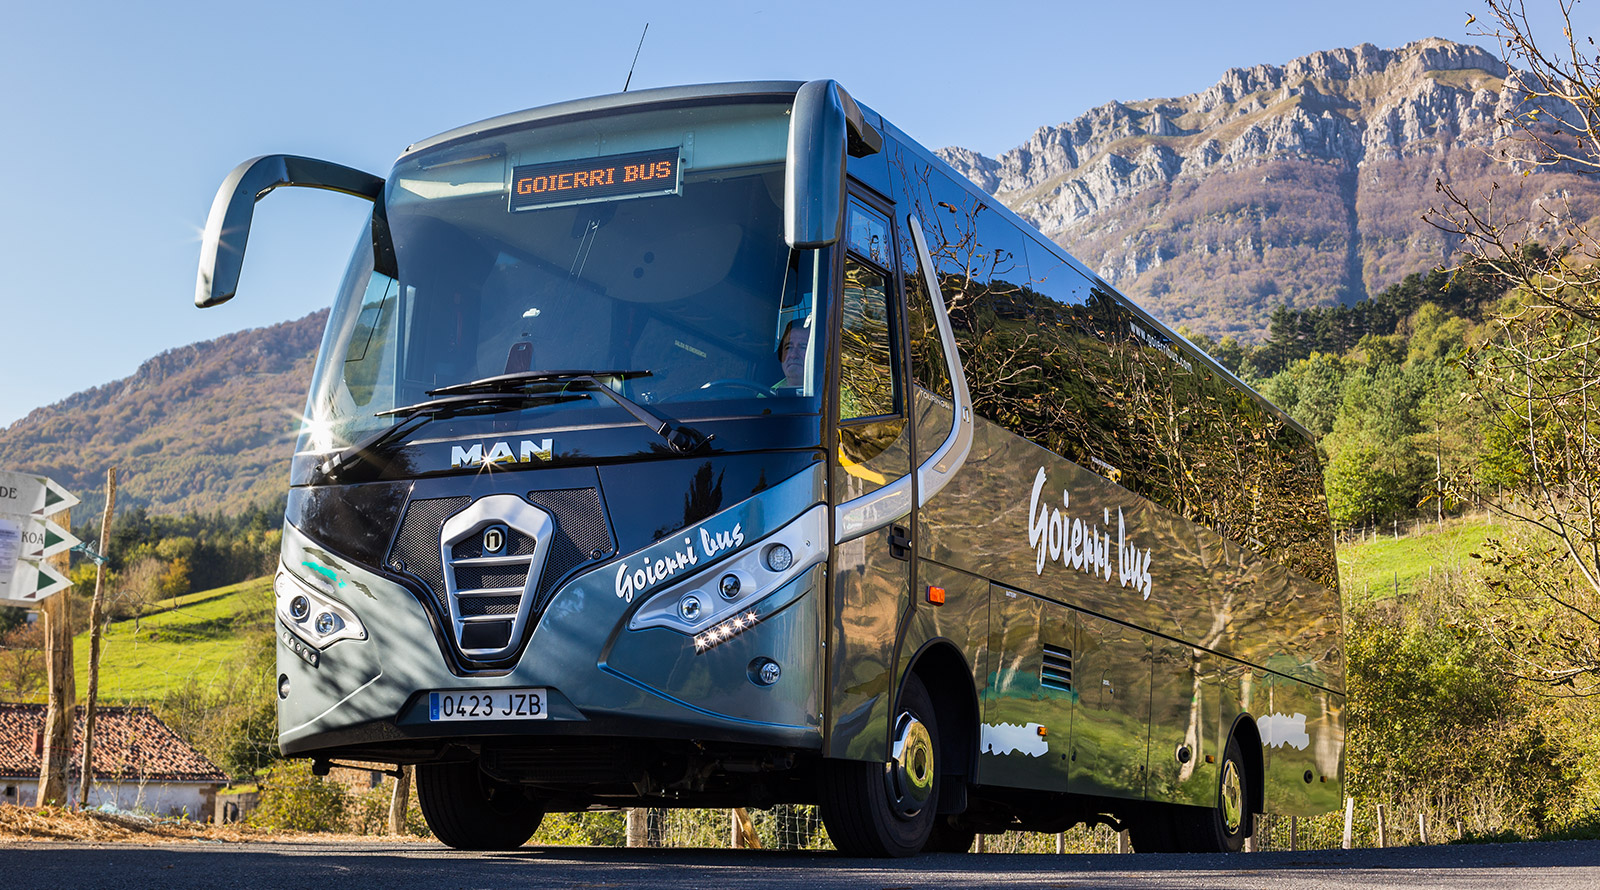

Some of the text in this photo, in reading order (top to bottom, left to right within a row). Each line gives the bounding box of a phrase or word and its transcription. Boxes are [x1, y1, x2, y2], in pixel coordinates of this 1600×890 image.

[517, 161, 671, 195] GOIERRI BUS
[451, 439, 553, 468] MAN
[1029, 466, 1152, 601] Goierri bus
[615, 522, 744, 603] Goierri bus
[443, 694, 541, 717] 0423 JZB
